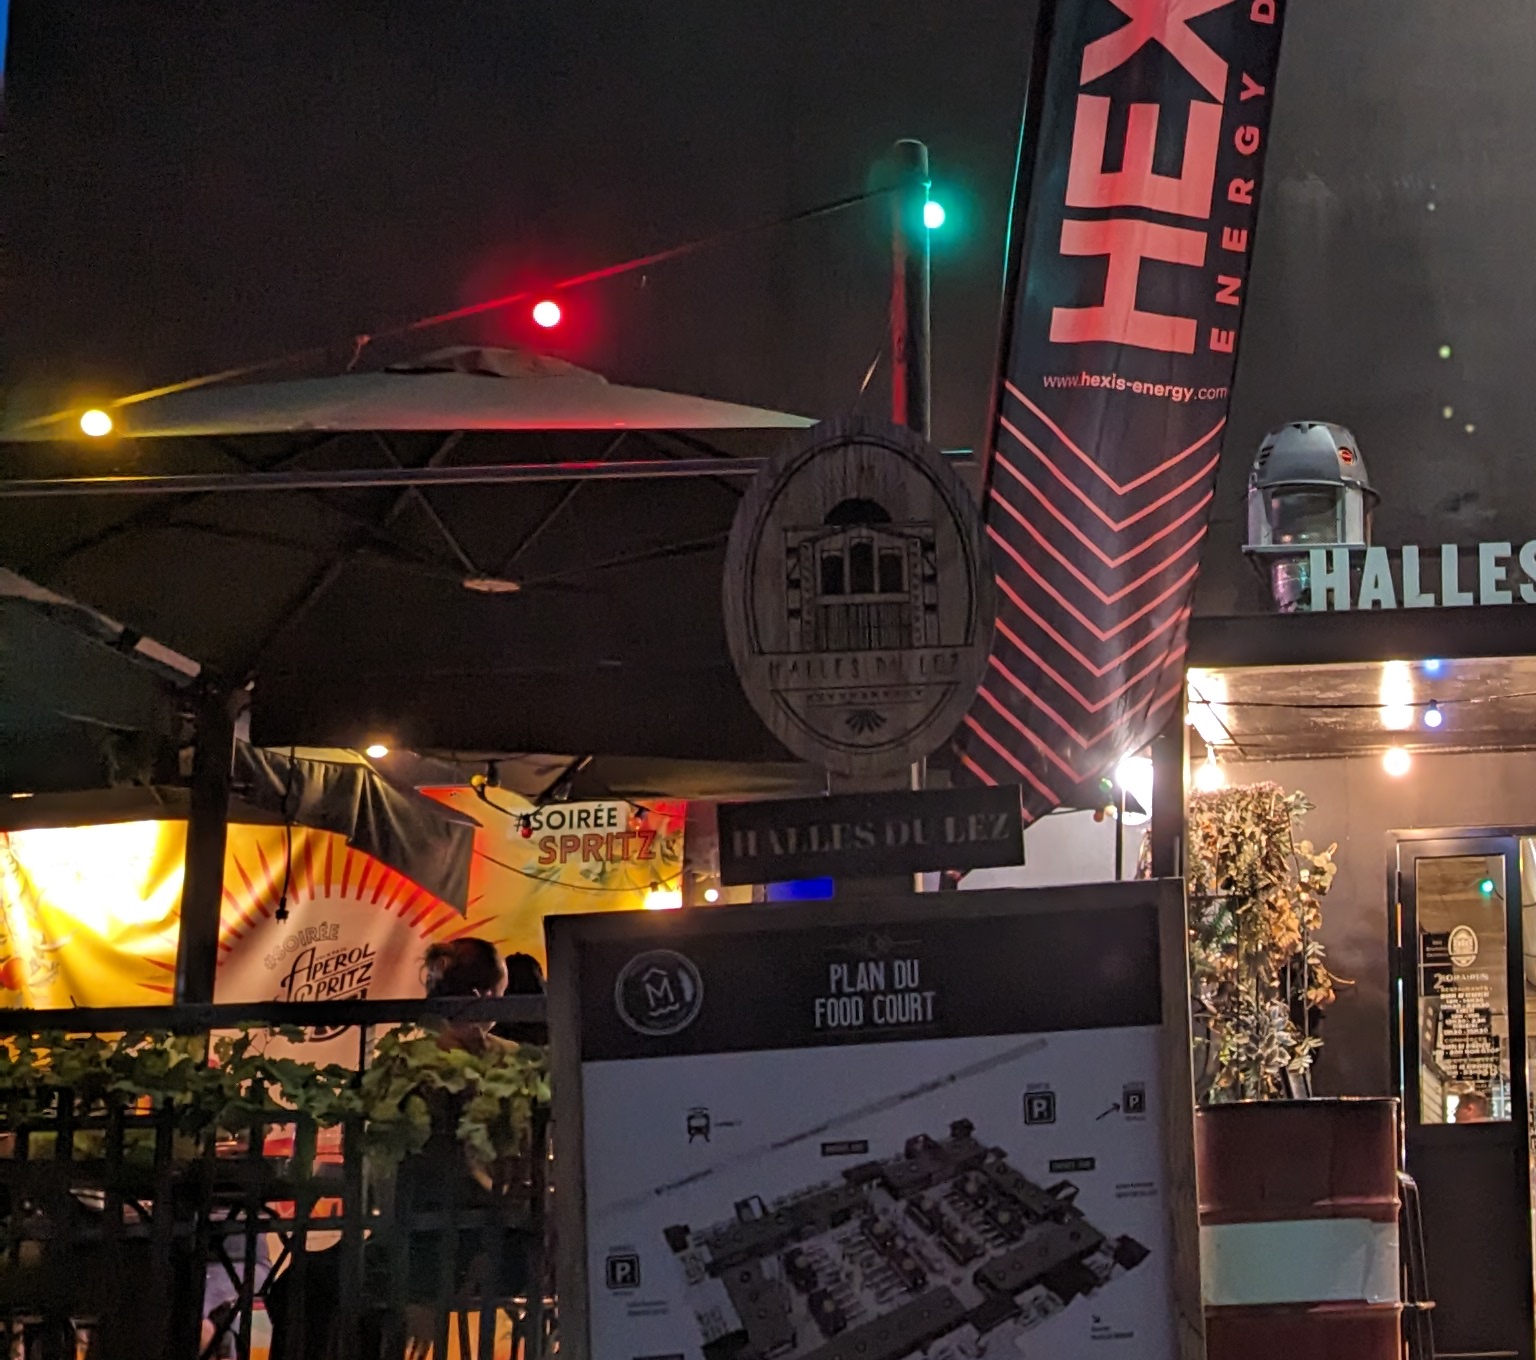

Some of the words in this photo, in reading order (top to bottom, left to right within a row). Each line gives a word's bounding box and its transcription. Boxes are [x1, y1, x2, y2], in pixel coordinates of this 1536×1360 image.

[1208, 79, 1266, 354] ENERGY
[1042, 370, 1228, 403] www.hexis-energy.com
[537, 830, 657, 865] SPRITZ
[732, 821, 878, 860] HALLES
[885, 817, 931, 847] DU
[945, 812, 1011, 844] LEZ
[263, 921, 340, 971] #SOIRÉE
[280, 943, 377, 1002] APEROL
[294, 961, 374, 1002] SPRITZ
[829, 960, 886, 994] PLAN
[893, 958, 920, 990] DU
[813, 995, 865, 1028] FOOD
[872, 991, 937, 1025] COURT
